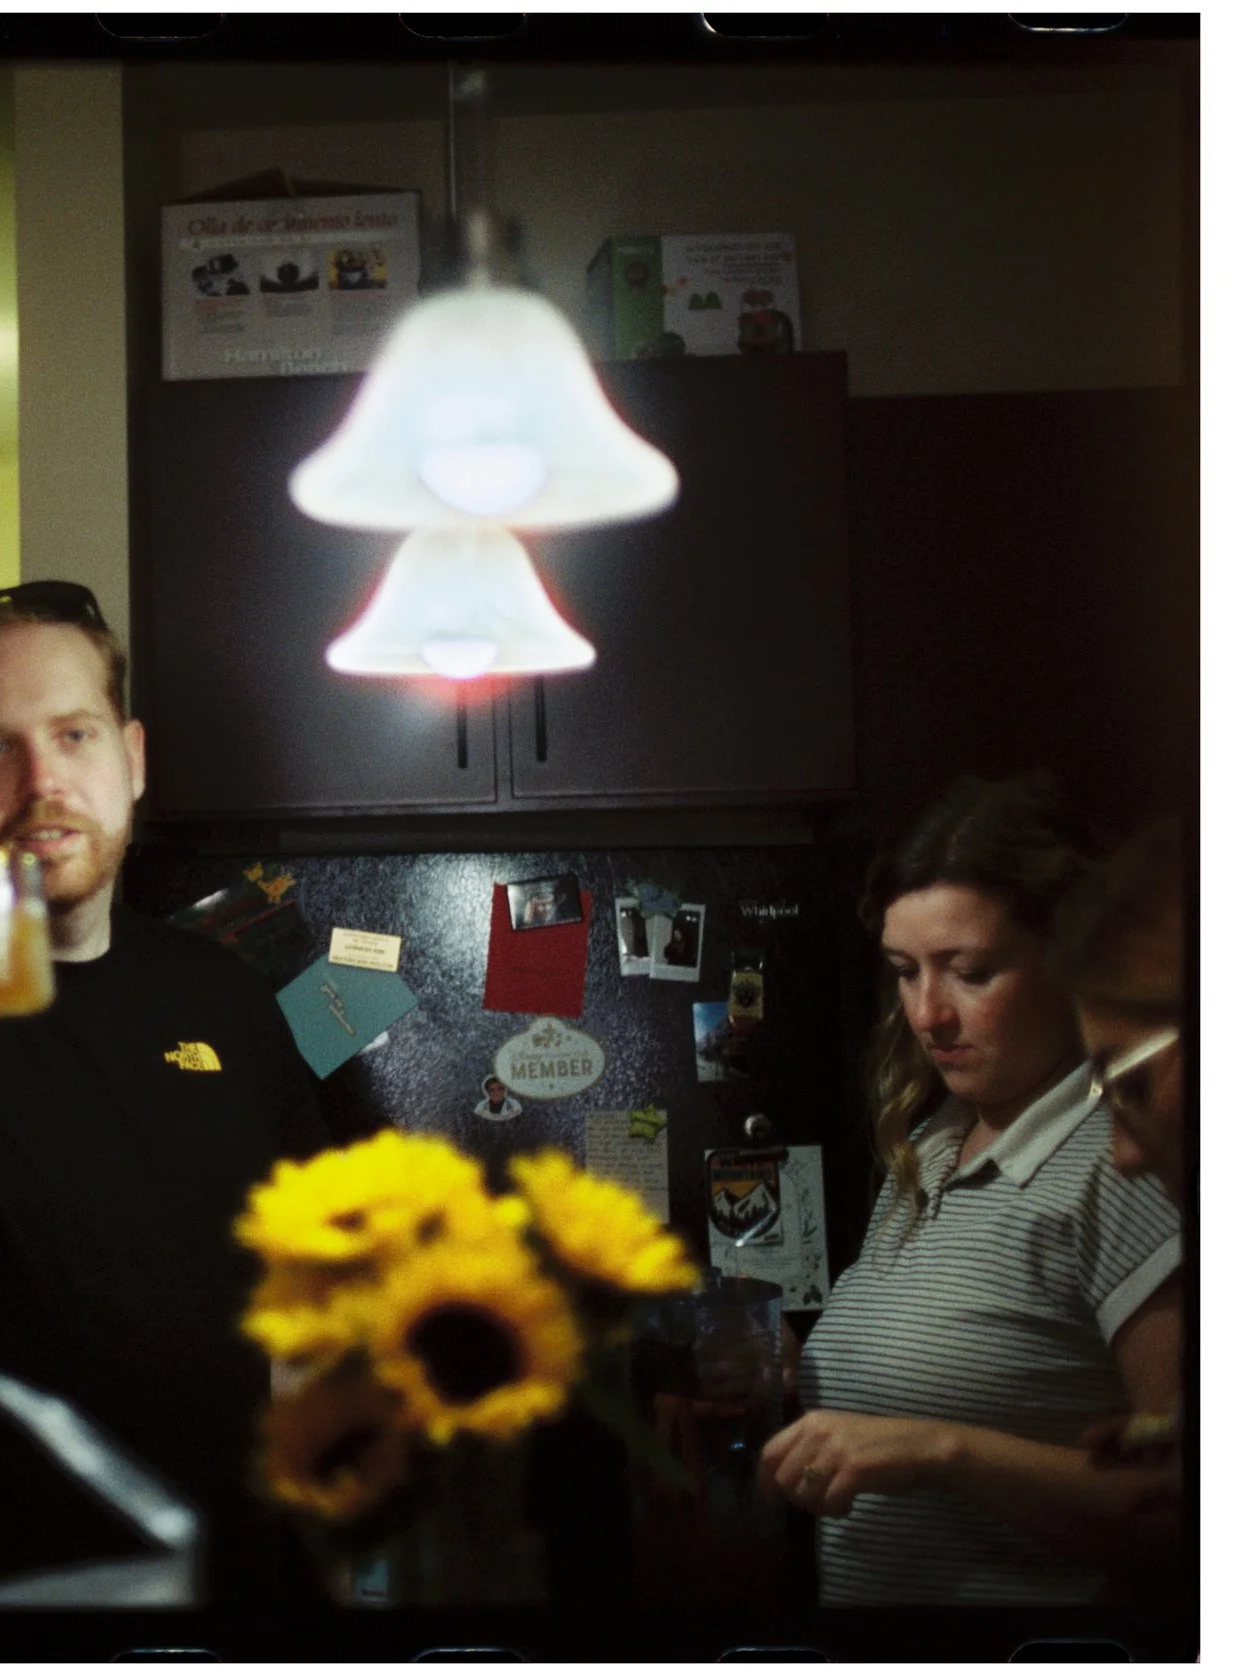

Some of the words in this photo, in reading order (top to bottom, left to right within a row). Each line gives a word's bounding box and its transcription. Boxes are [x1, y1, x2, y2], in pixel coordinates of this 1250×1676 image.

[187, 216, 227, 236] Olla
[231, 214, 253, 233] de
[353, 210, 398, 227] lento
[740, 903, 799, 920] Whirlpool
[178, 1042, 196, 1052] THE
[165, 1050, 200, 1063] NORTH
[179, 1060, 205, 1071] FACE
[511, 1059, 594, 1080] MEMBER
